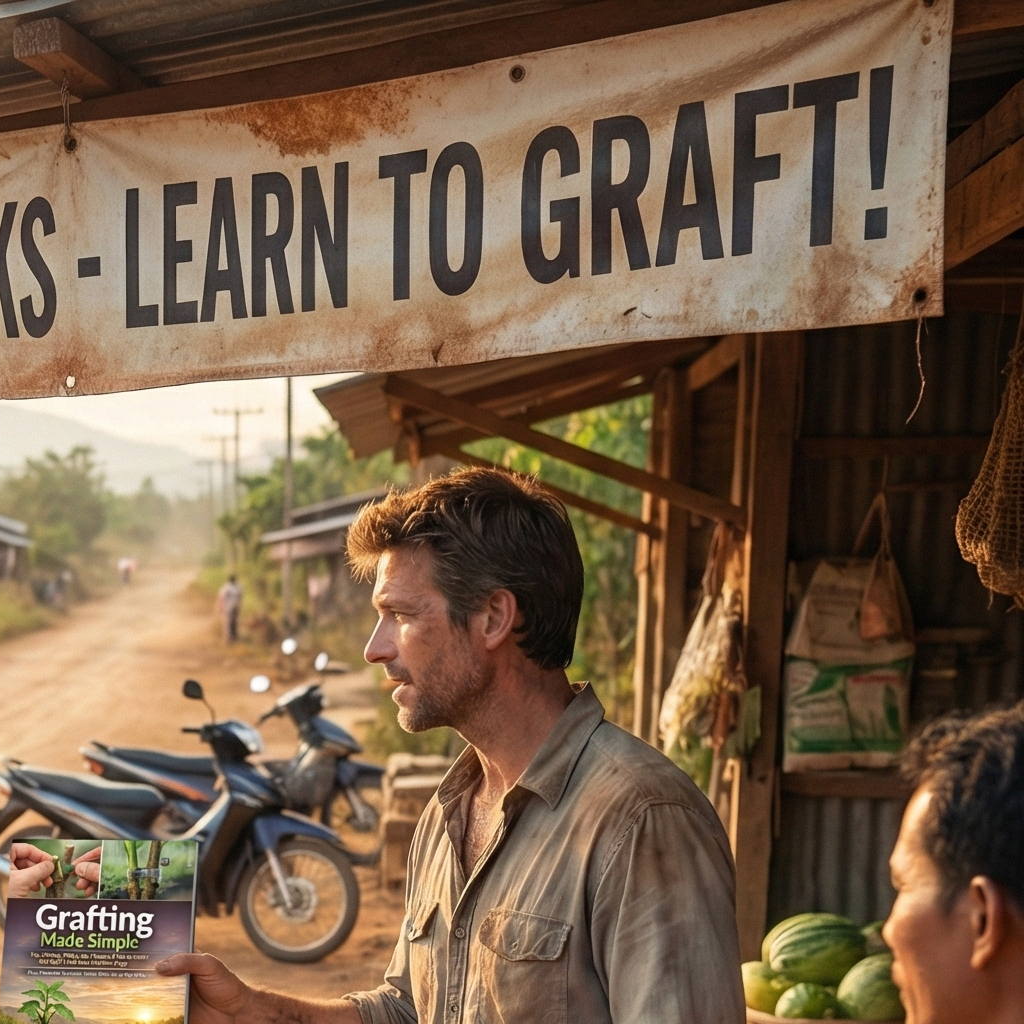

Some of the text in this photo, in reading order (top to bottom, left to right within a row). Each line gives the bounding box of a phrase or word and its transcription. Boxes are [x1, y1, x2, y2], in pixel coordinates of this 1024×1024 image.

[78, 256, 102, 279] -
[125, 160, 349, 330] LEARN
[378, 140, 484, 301] TO
[520, 65, 895, 286] GRAFT!
[35, 903, 155, 939] Grafting
[40, 931, 84, 948] Made
